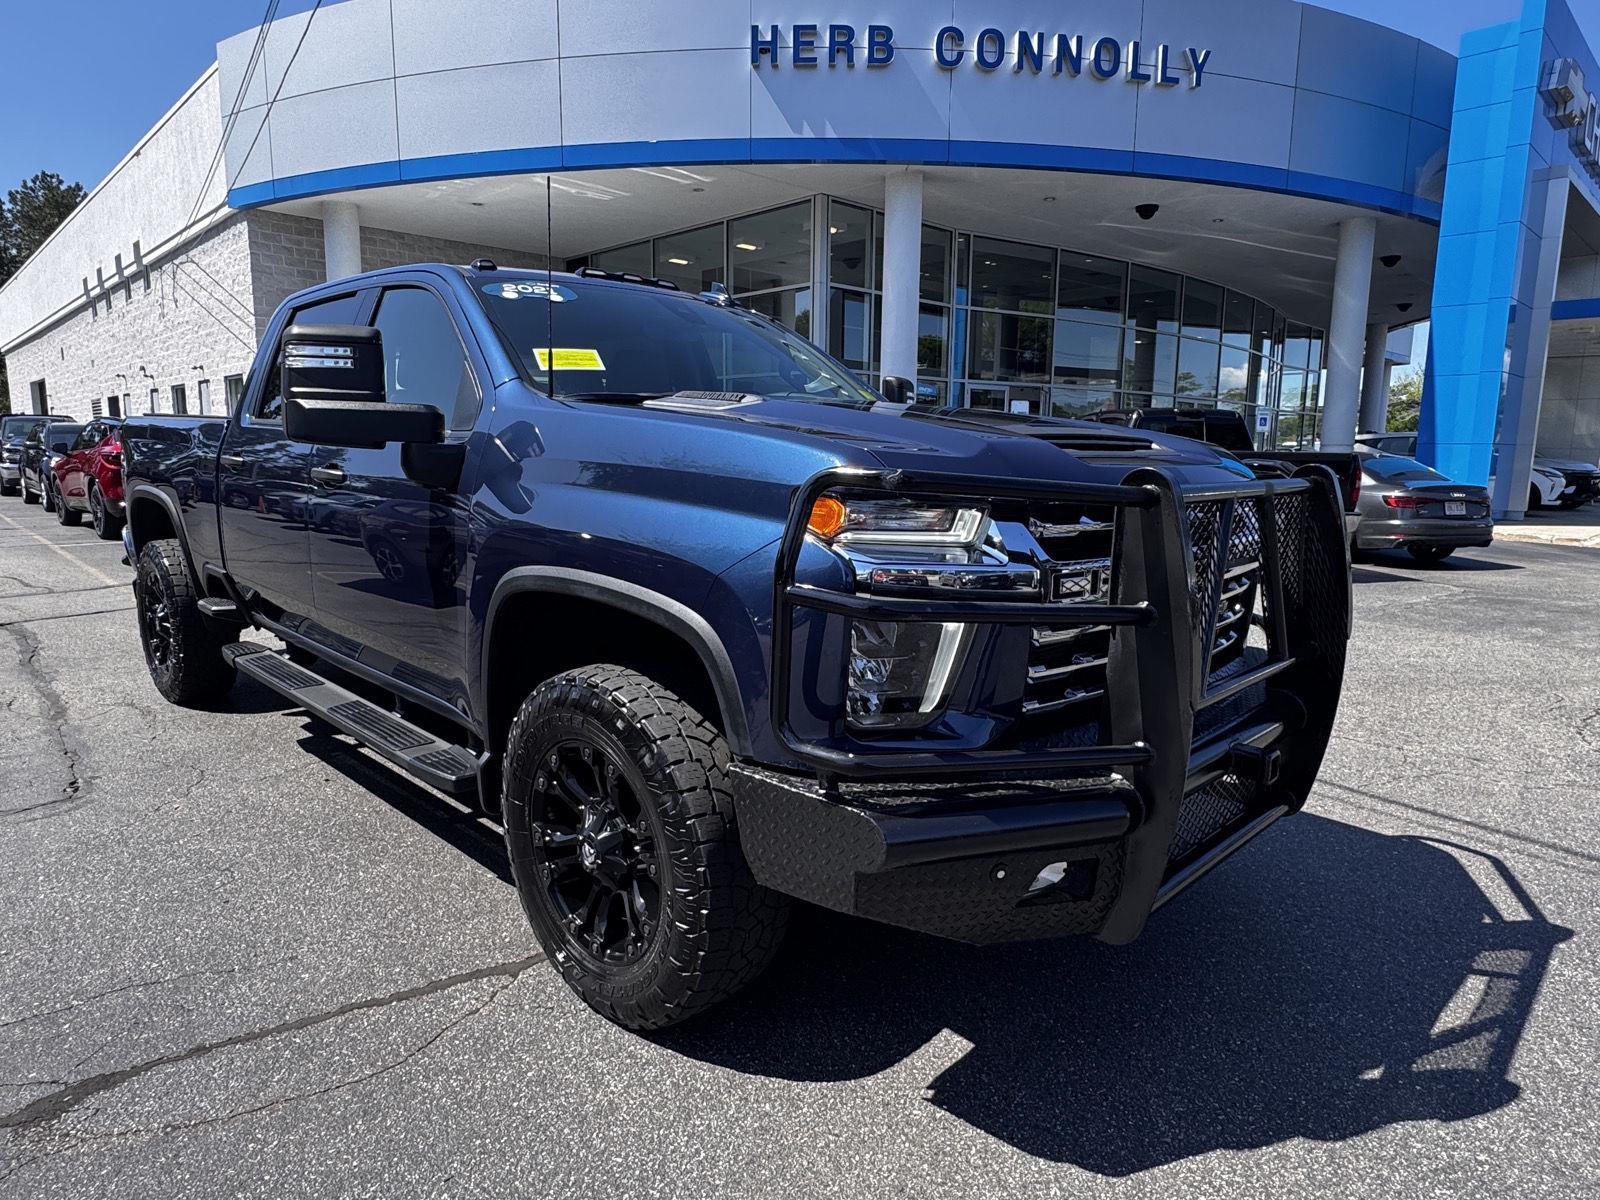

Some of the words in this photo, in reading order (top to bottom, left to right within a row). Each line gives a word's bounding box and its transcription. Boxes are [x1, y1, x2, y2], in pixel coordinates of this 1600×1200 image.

[751, 25, 895, 67] HERB
[935, 26, 1212, 88] CONNOLLY
[502, 283, 558, 295] 2021
